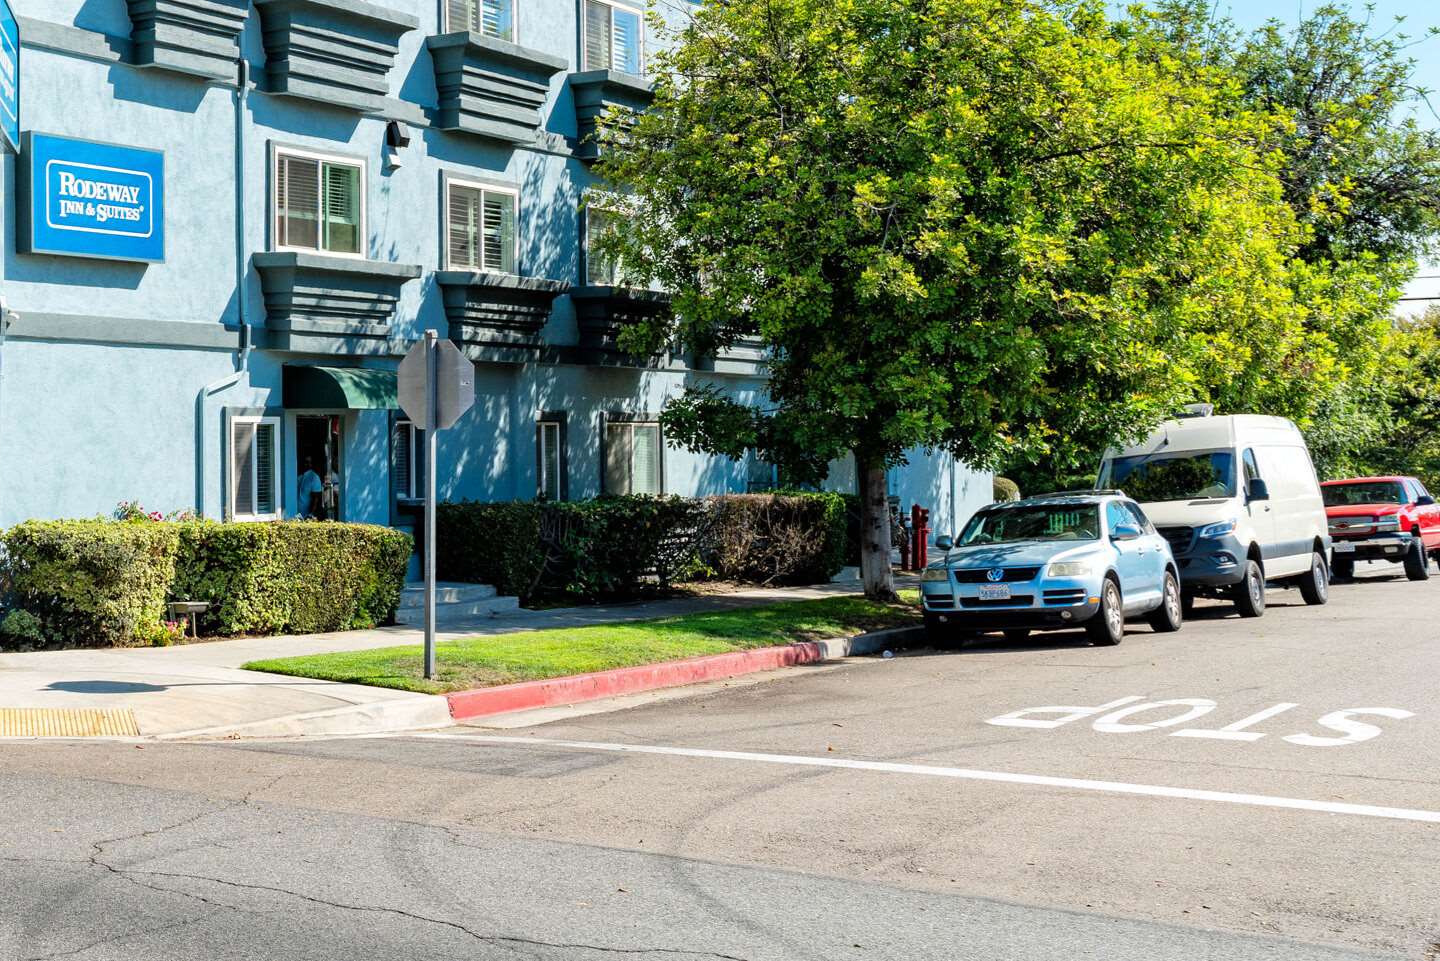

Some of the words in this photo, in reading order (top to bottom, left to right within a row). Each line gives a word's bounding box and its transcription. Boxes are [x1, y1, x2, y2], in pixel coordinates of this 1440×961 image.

[59, 172, 140, 204] RODEWAY
[59, 200, 84, 217] INN
[86, 203, 95, 216] &
[96, 204, 140, 222] SUITES
[984, 695, 1416, 747] STOP
